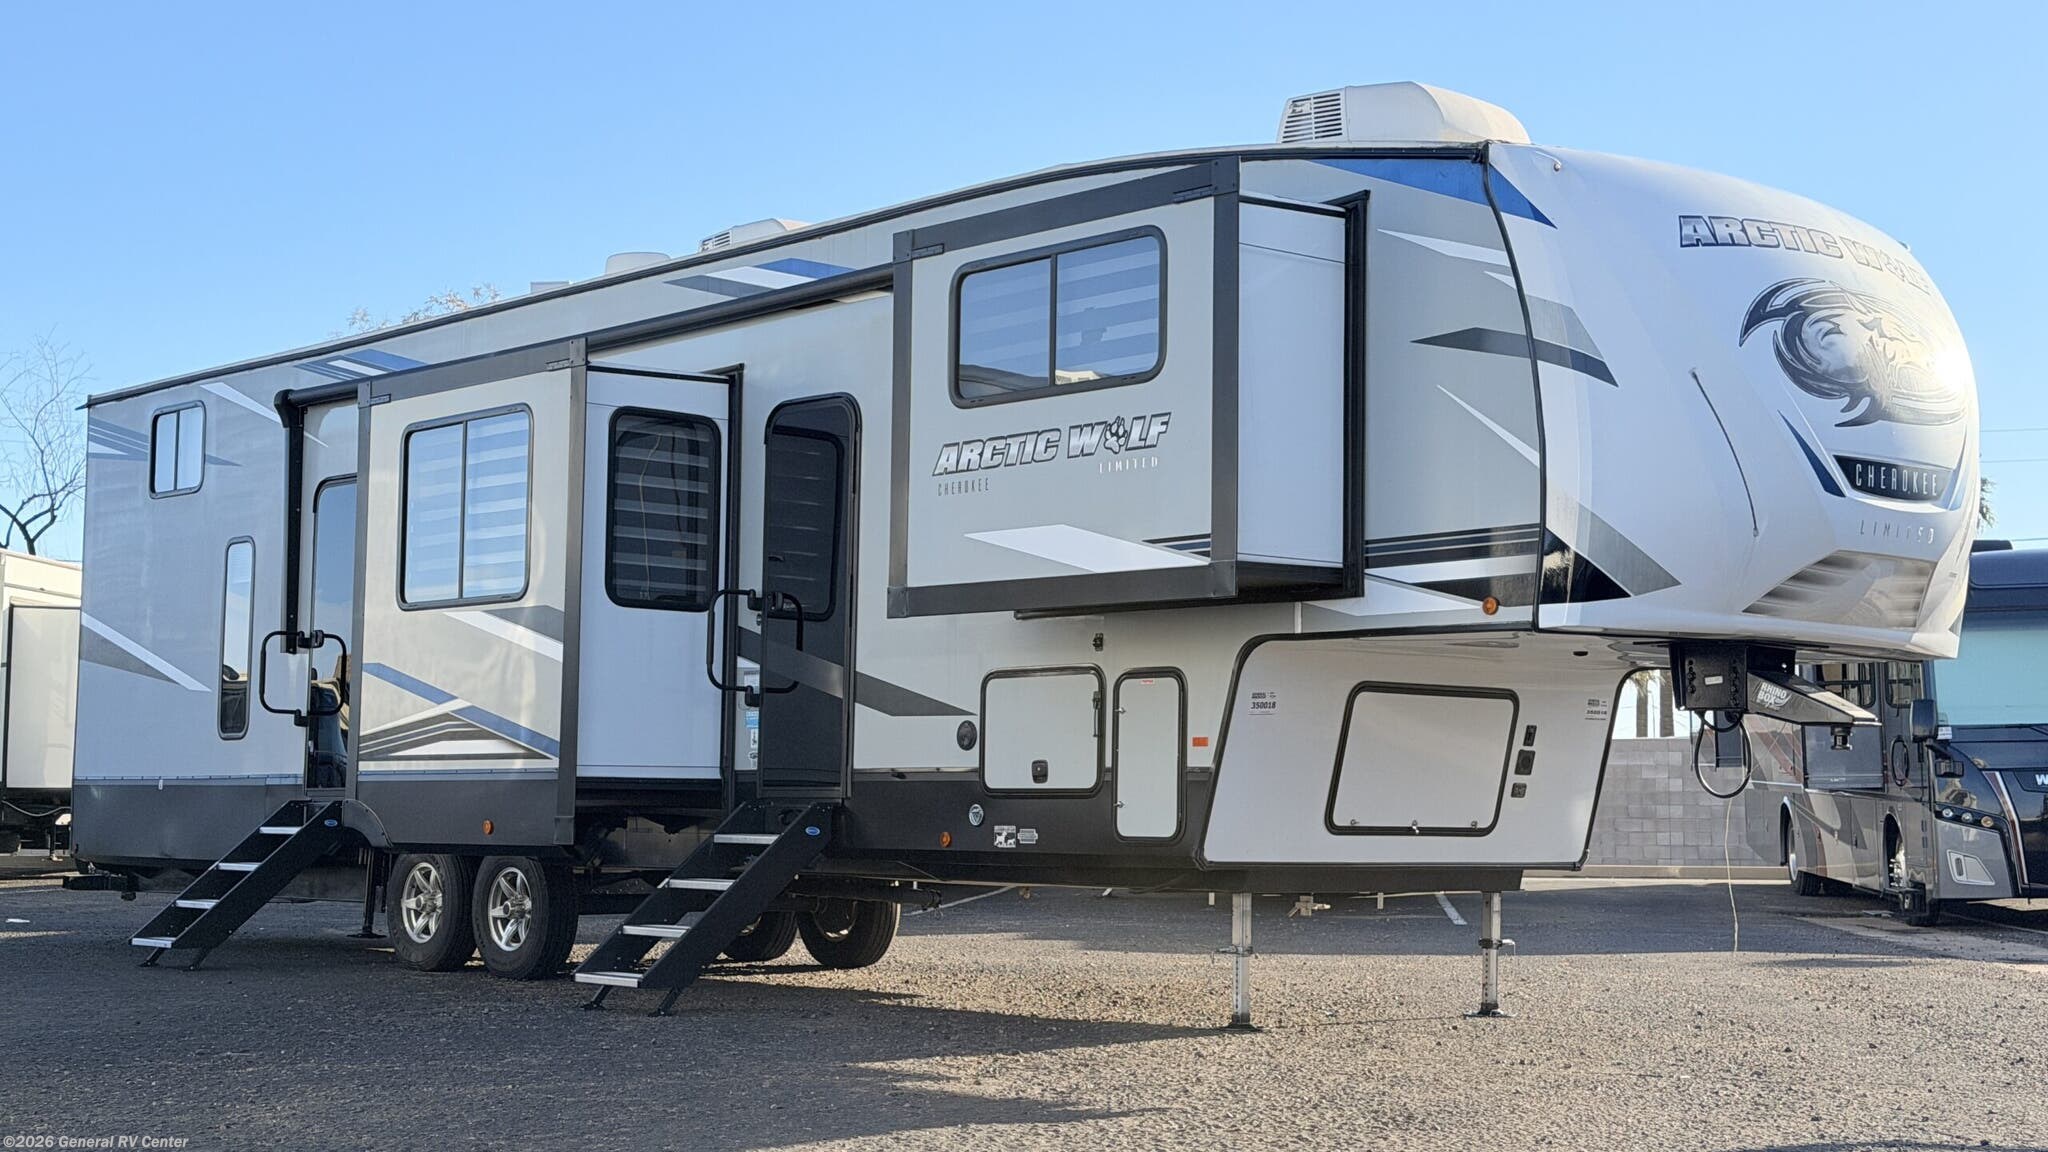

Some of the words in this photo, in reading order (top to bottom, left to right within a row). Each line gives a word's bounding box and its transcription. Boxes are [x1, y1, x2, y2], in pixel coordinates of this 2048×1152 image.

[1678, 214, 1845, 260] ARCTIC
[932, 428, 1061, 476] ARCTIC
[1098, 456, 1158, 475] LIMITED
[937, 477, 990, 497] CHEROKEE
[1855, 463, 1938, 497] CHEROKEE
[1757, 690, 1777, 705] BOX
[1760, 681, 1787, 699] RHINO
